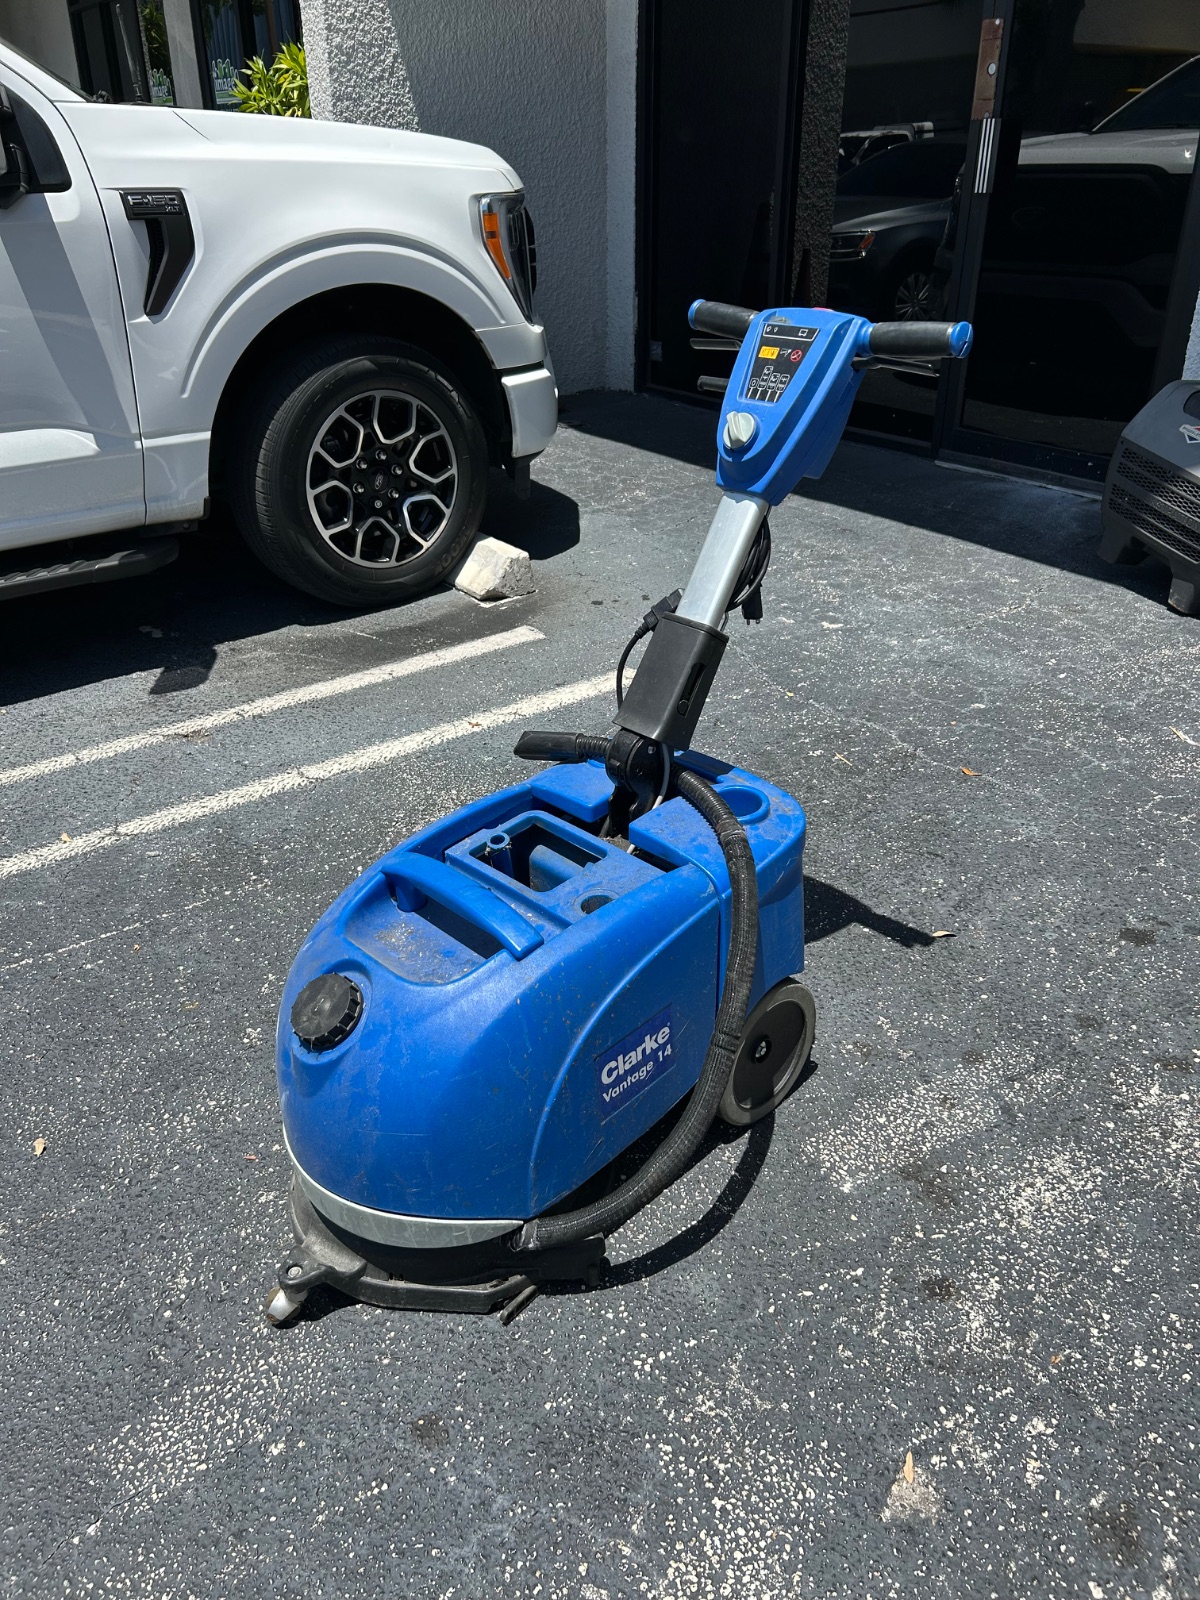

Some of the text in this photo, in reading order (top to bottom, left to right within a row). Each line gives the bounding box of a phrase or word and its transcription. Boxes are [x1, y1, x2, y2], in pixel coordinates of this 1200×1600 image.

[128, 194, 180, 206] F-150
[601, 1026, 671, 1084] Clarke
[602, 1043, 672, 1102] Vantage 14
